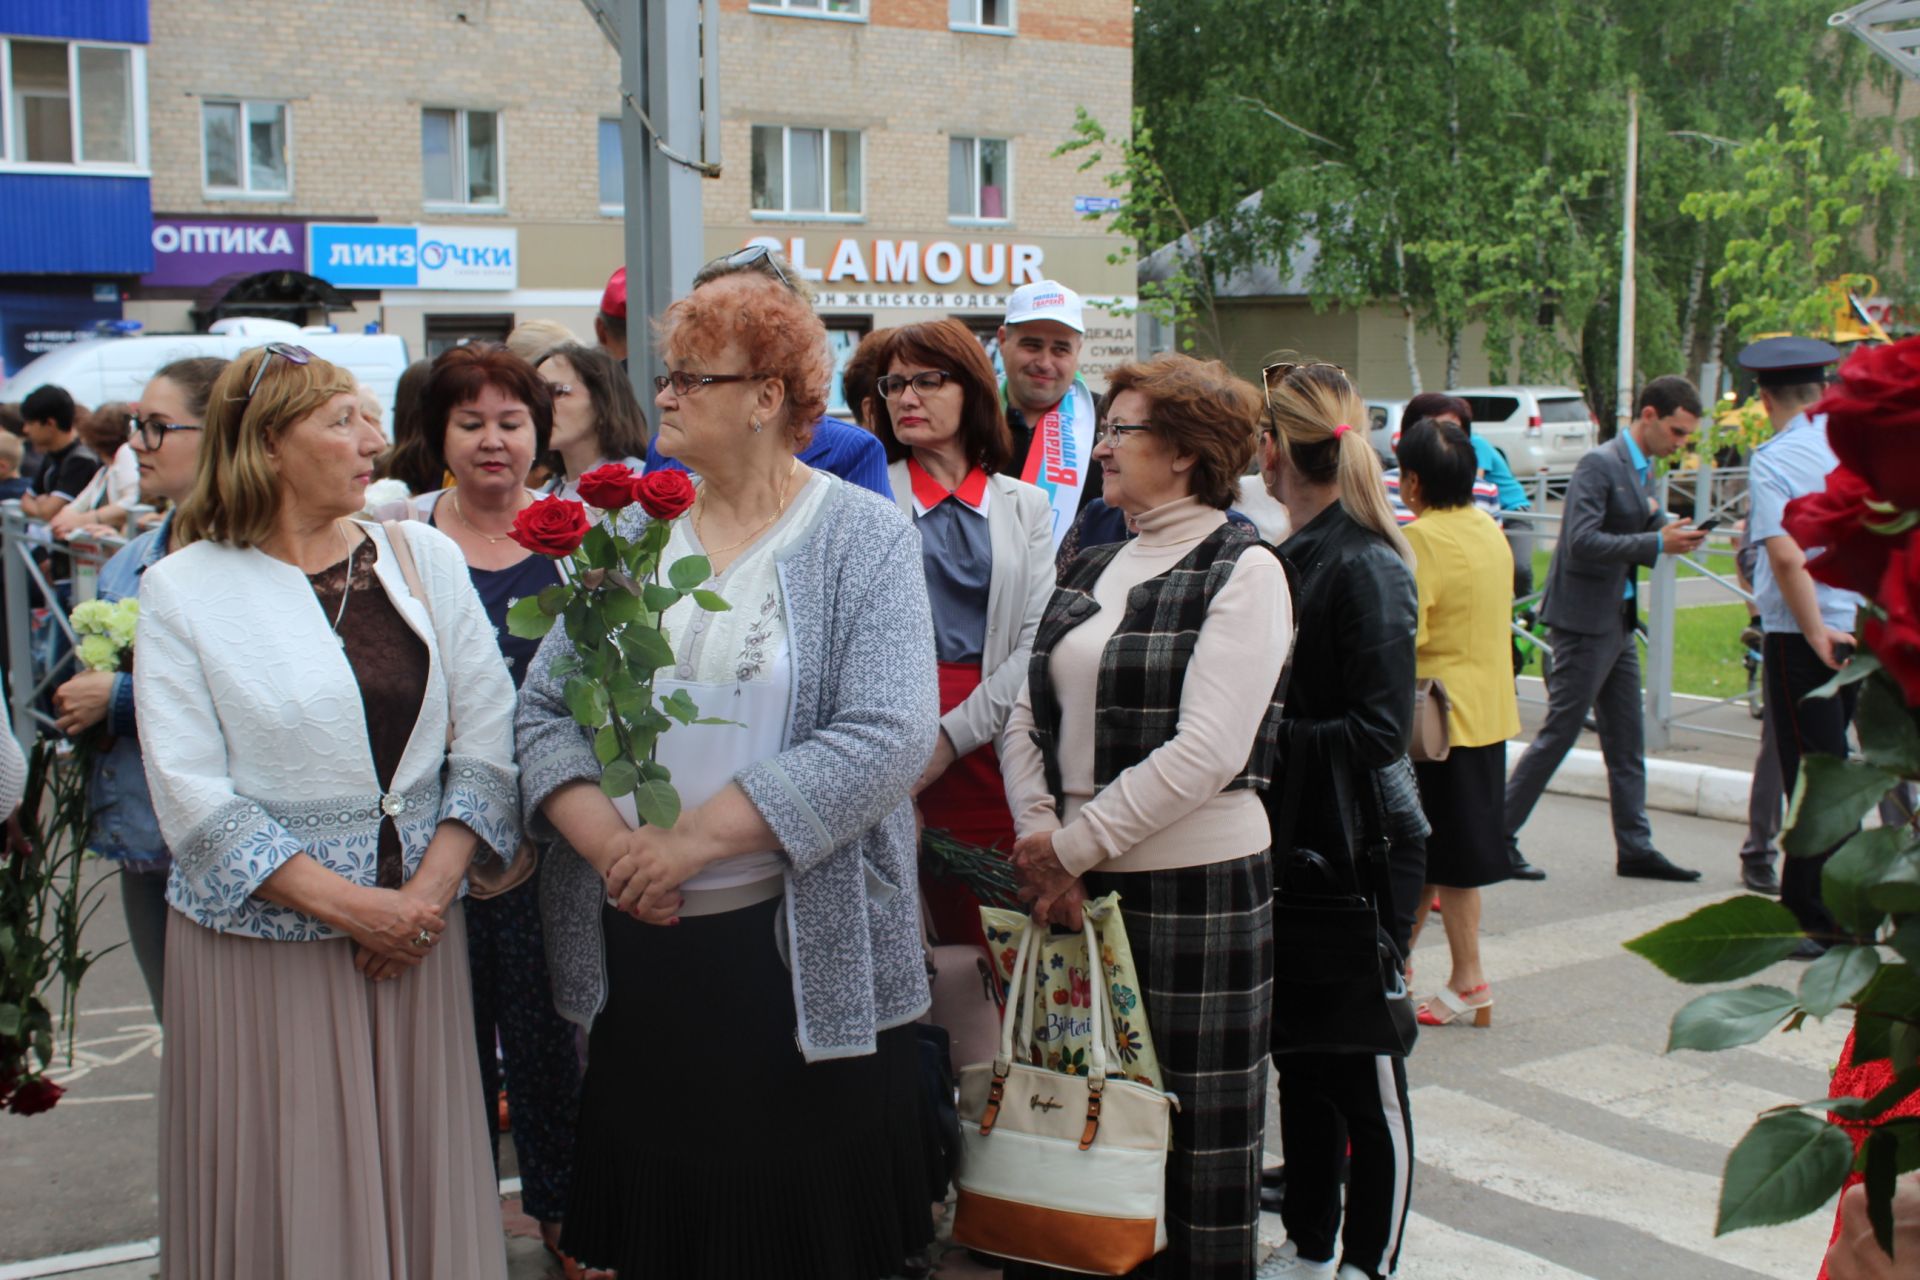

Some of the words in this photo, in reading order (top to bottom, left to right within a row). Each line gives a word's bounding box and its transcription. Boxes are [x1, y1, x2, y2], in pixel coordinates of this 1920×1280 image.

[151, 226, 294, 254] ОПТИКА
[846, 293, 945, 306] ЖЕНСКОЙ
[955, 296, 1006, 307] ОДЕЖ
[1084, 328, 1133, 339] ДЕЖДА
[1090, 346, 1134, 356] СУМКИ
[1045, 413, 1078, 487] ГВАРДИЯ
